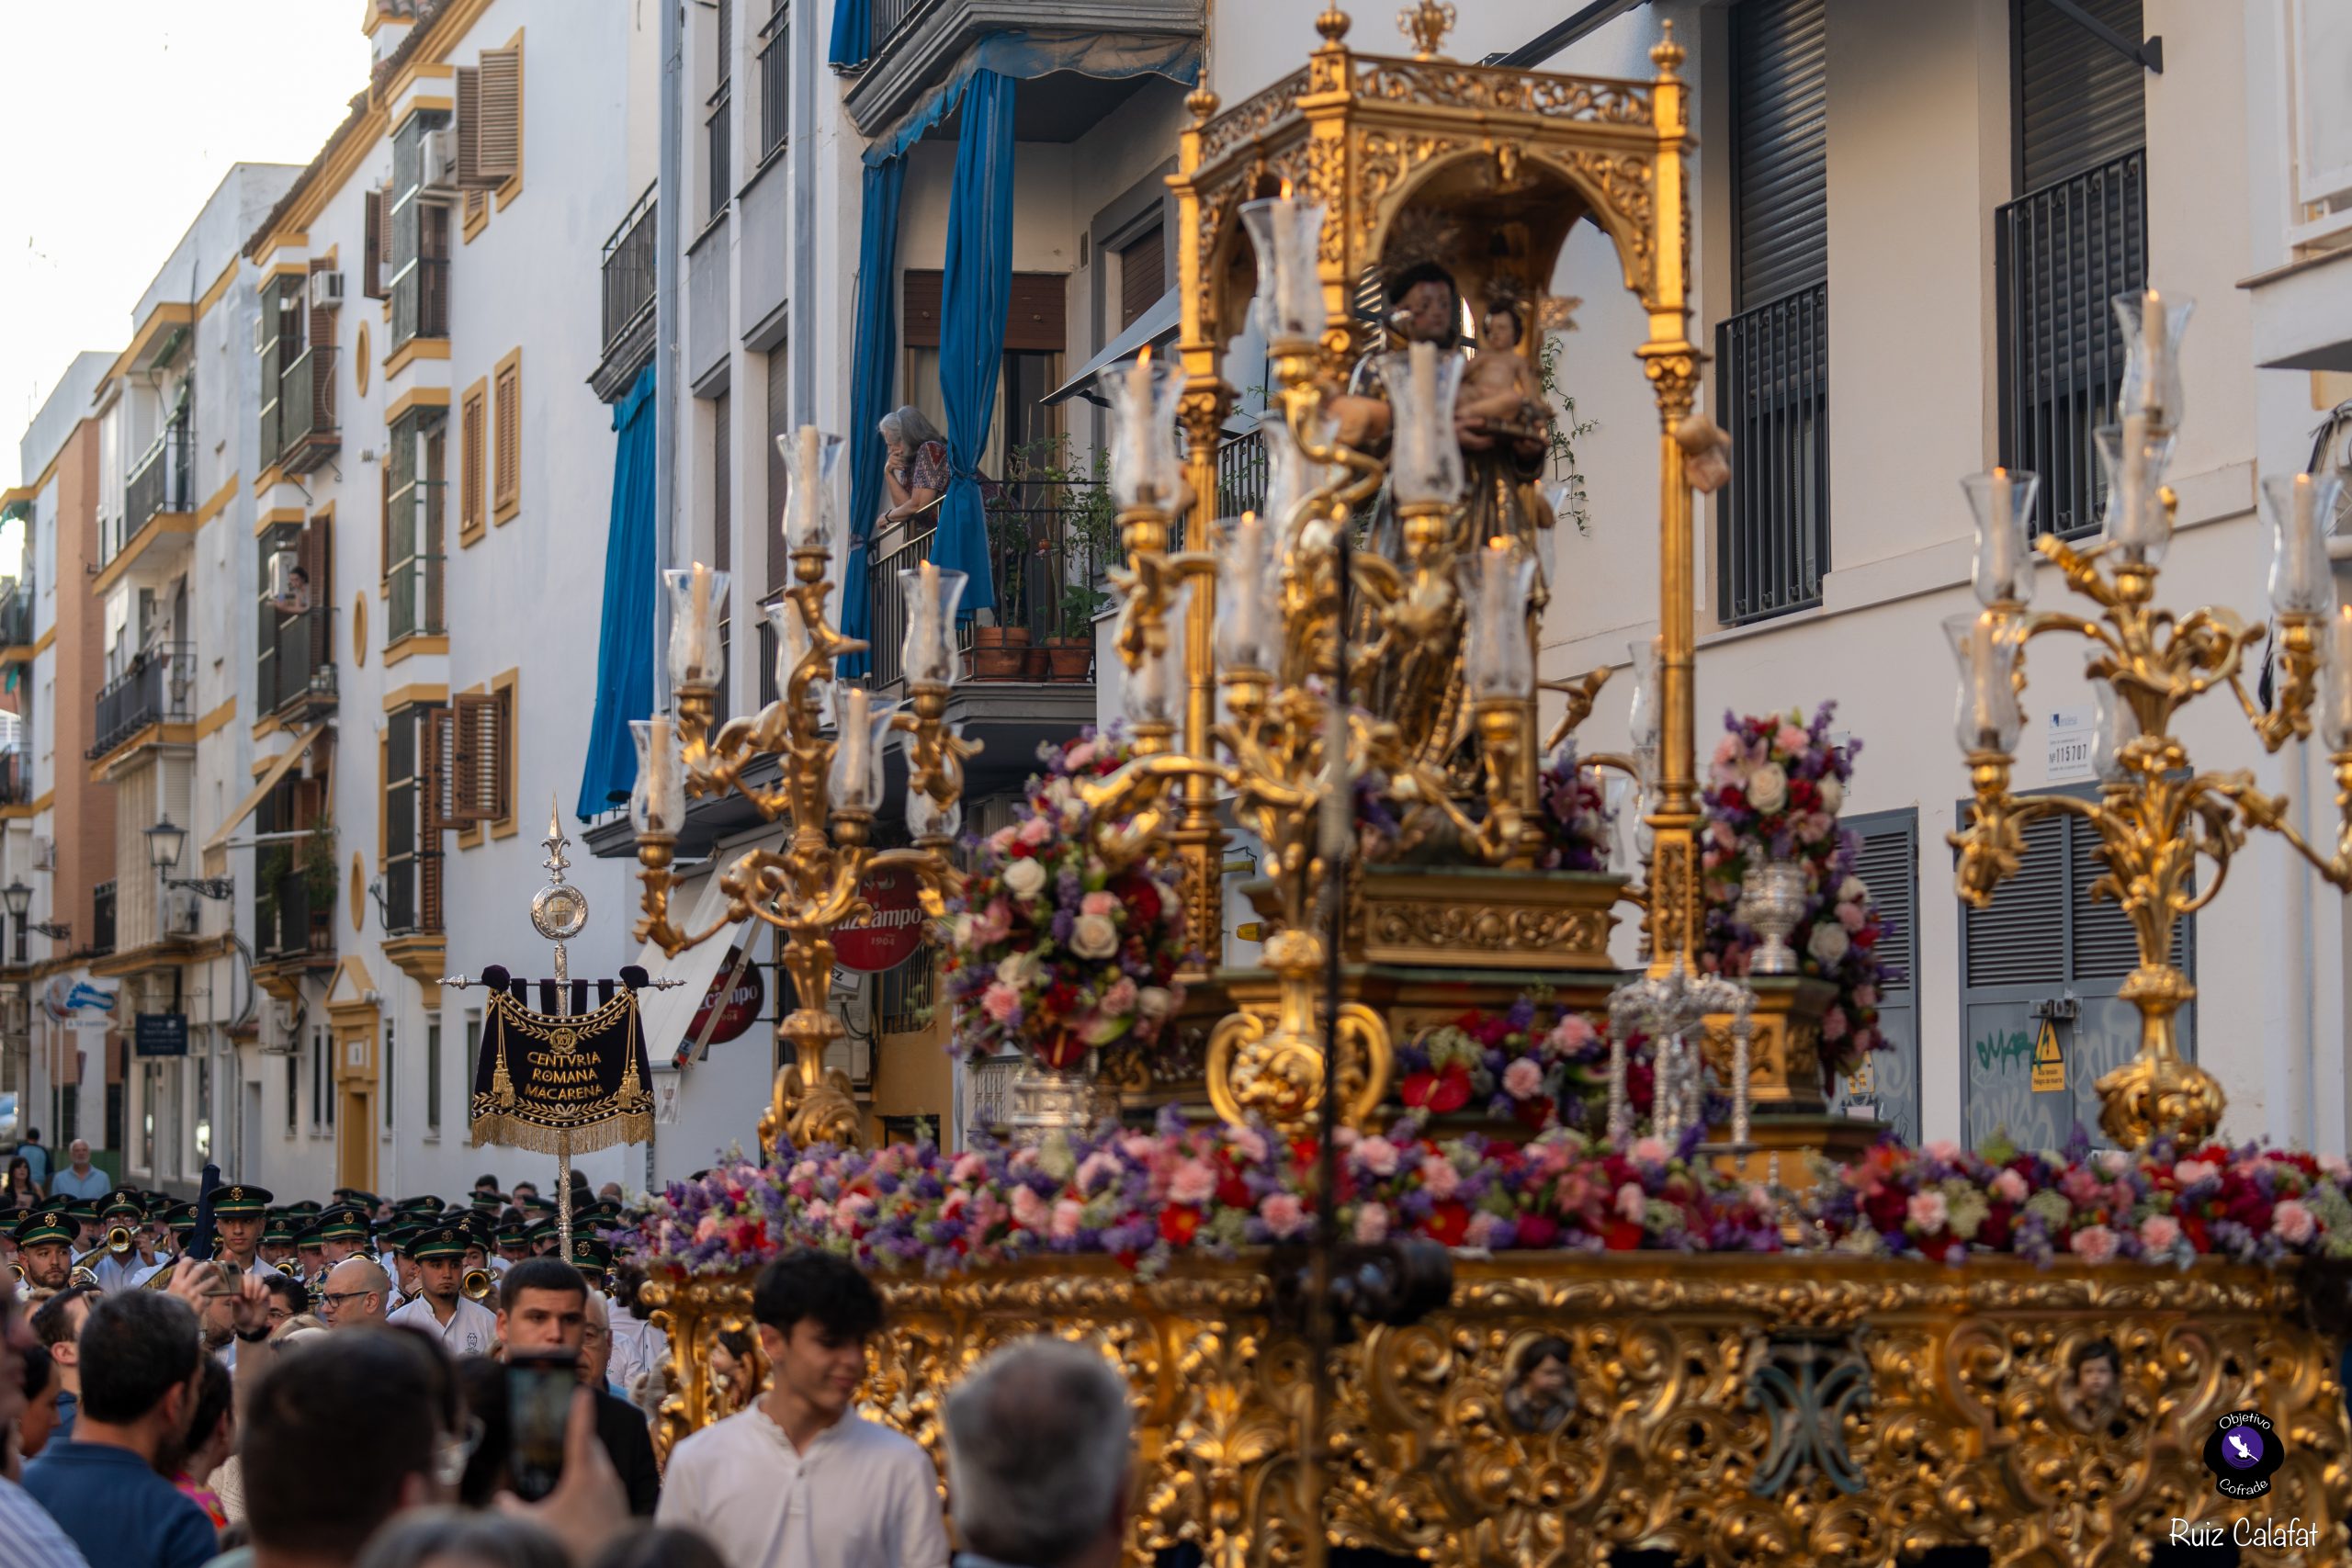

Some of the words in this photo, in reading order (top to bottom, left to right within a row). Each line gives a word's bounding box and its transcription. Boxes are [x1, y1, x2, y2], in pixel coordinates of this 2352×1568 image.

[871, 937, 896, 946] 1904
[721, 1013, 738, 1021] 904
[526, 1051, 602, 1067] CENTVRIA
[531, 1067, 599, 1084] ROMANA
[524, 1083, 604, 1100] MACARENA
